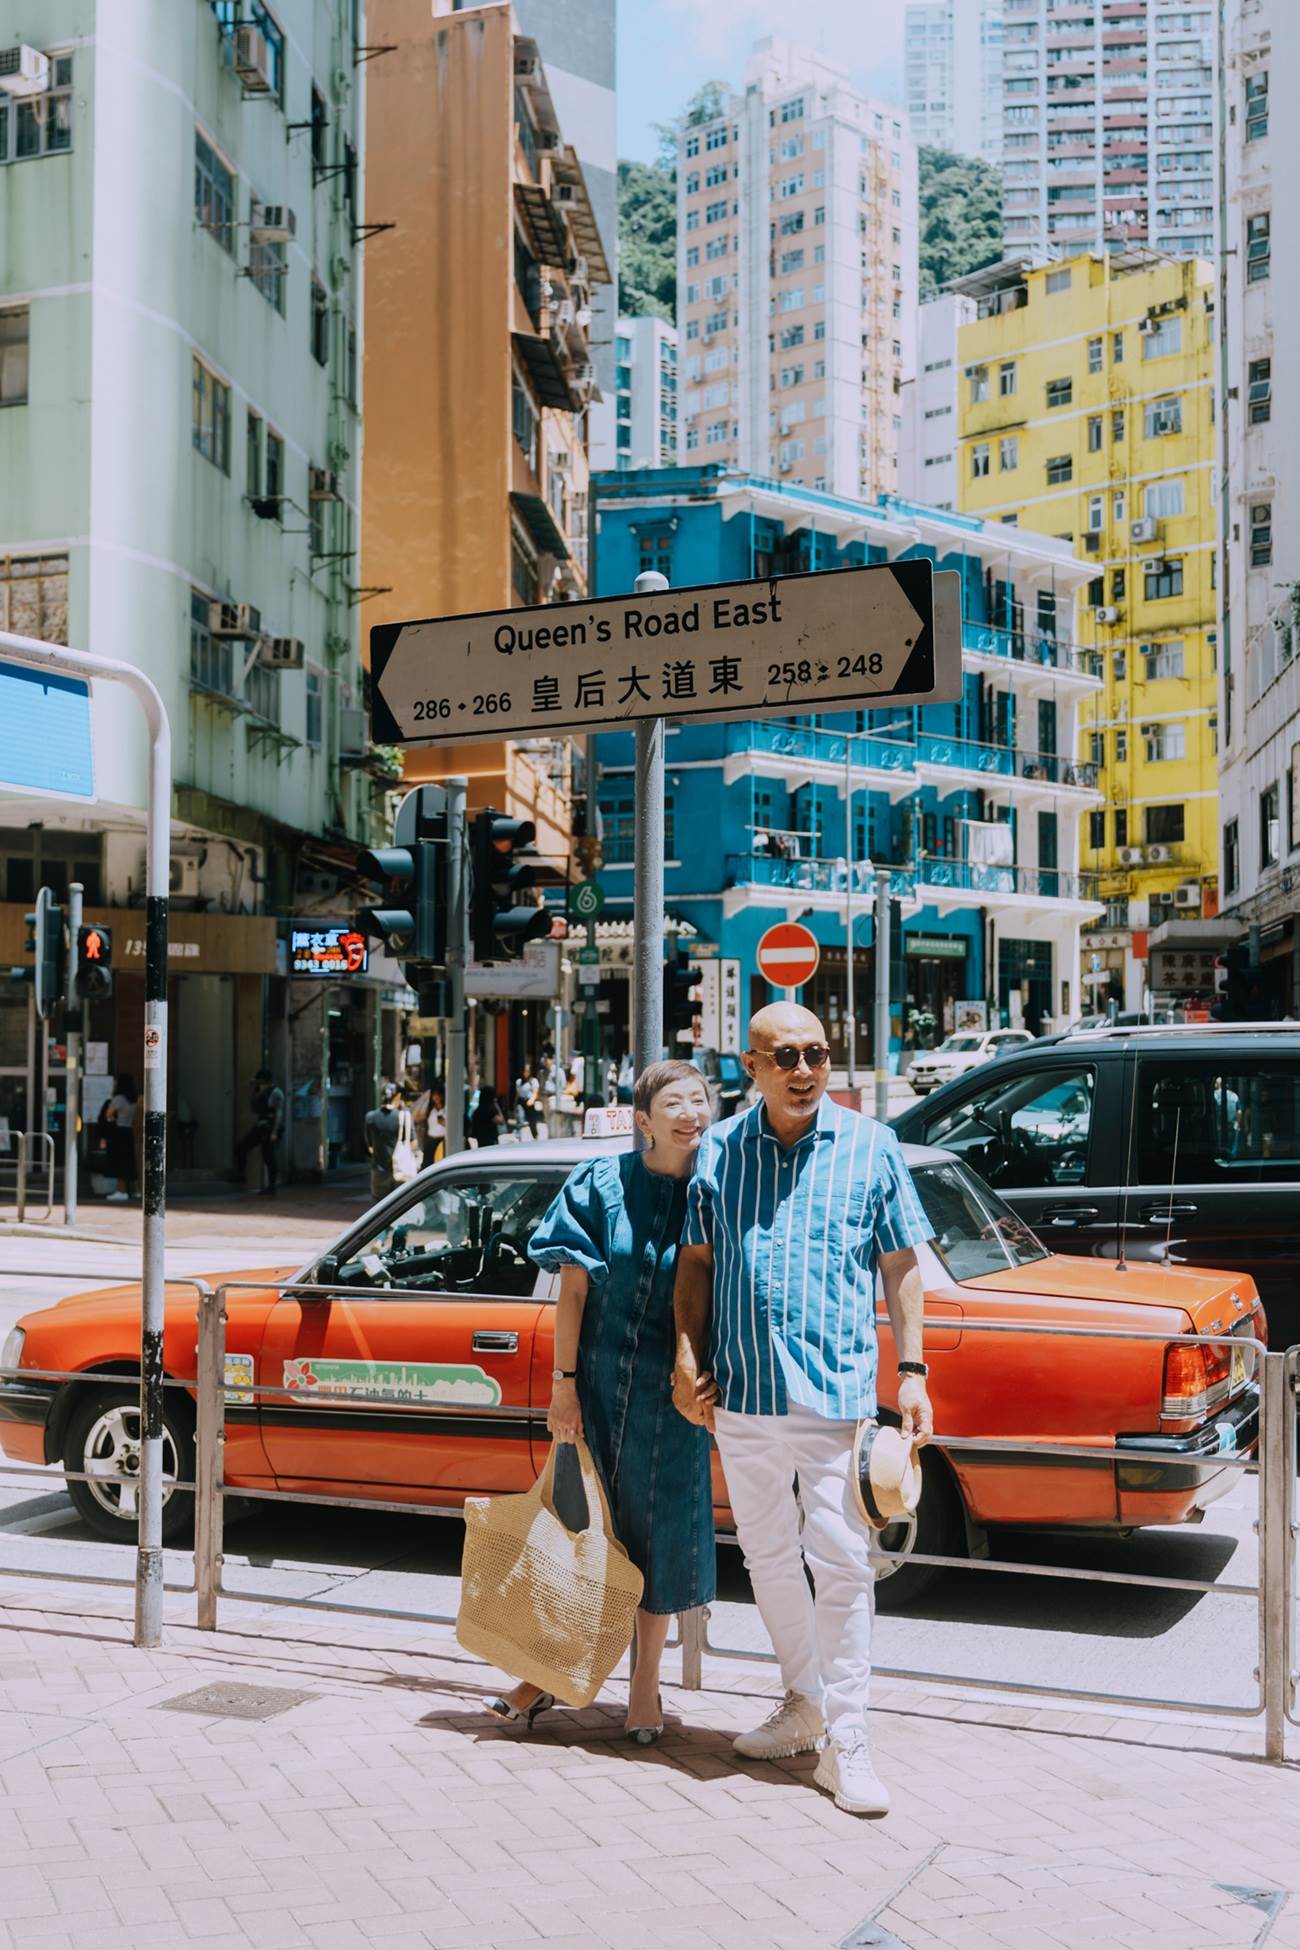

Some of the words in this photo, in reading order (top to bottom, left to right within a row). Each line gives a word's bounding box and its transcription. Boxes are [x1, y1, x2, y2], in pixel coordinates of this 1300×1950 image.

[494, 615, 612, 655] Queen's
[624, 603, 700, 639] Road
[713, 597, 782, 629] East
[531, 655, 744, 713] 皇后大道東
[767, 659, 812, 685] 258
[837, 652, 883, 679] 248
[413, 698, 451, 721] 286
[472, 692, 512, 716] 266
[577, 886, 597, 913] 6
